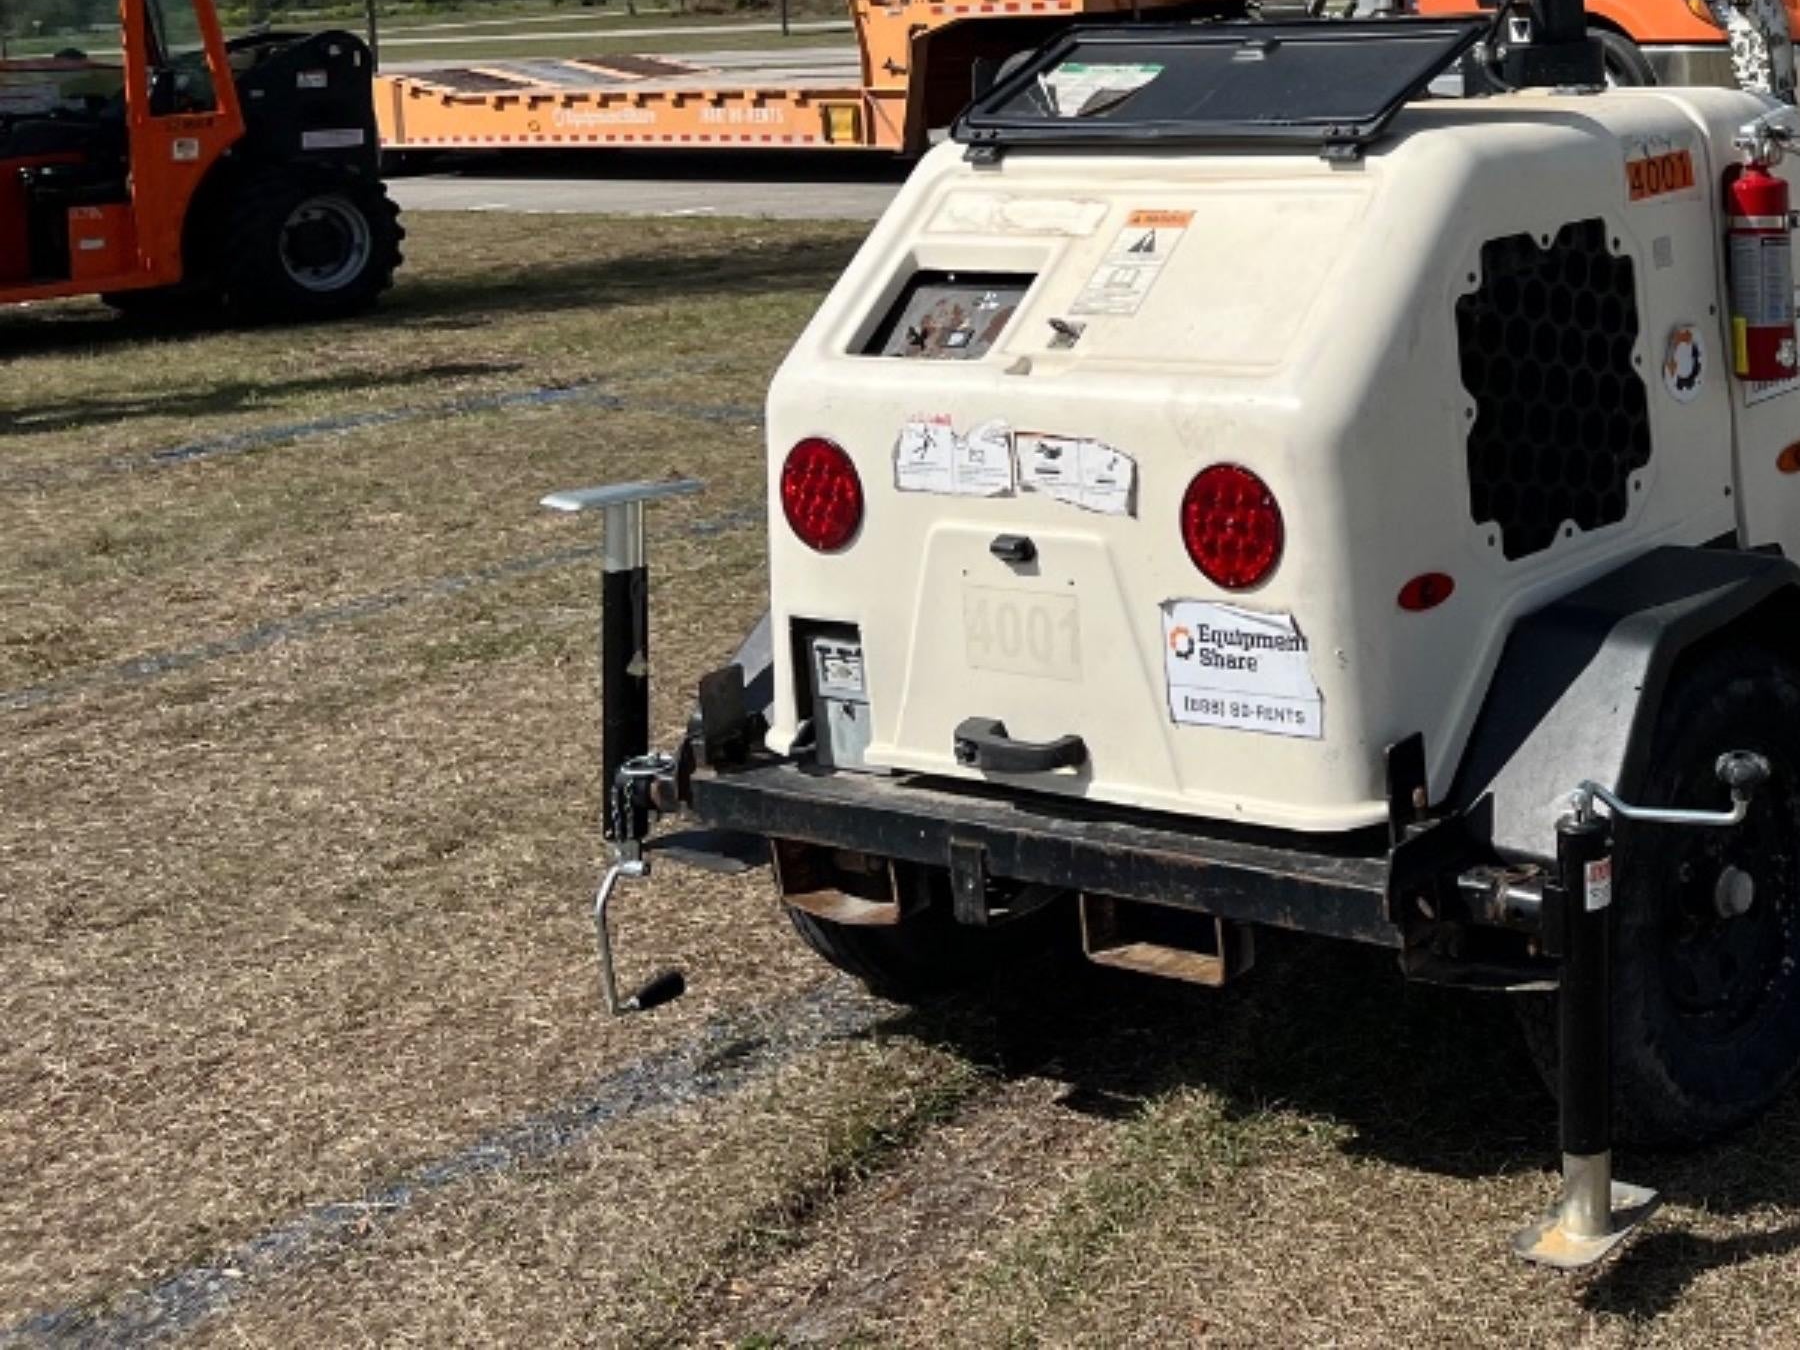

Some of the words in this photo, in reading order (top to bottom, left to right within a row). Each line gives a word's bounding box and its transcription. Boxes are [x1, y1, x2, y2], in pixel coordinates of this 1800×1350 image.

[1630, 153, 1688, 197] 4001
[1197, 623, 1308, 652] Equipment
[1200, 647, 1258, 673] Share
